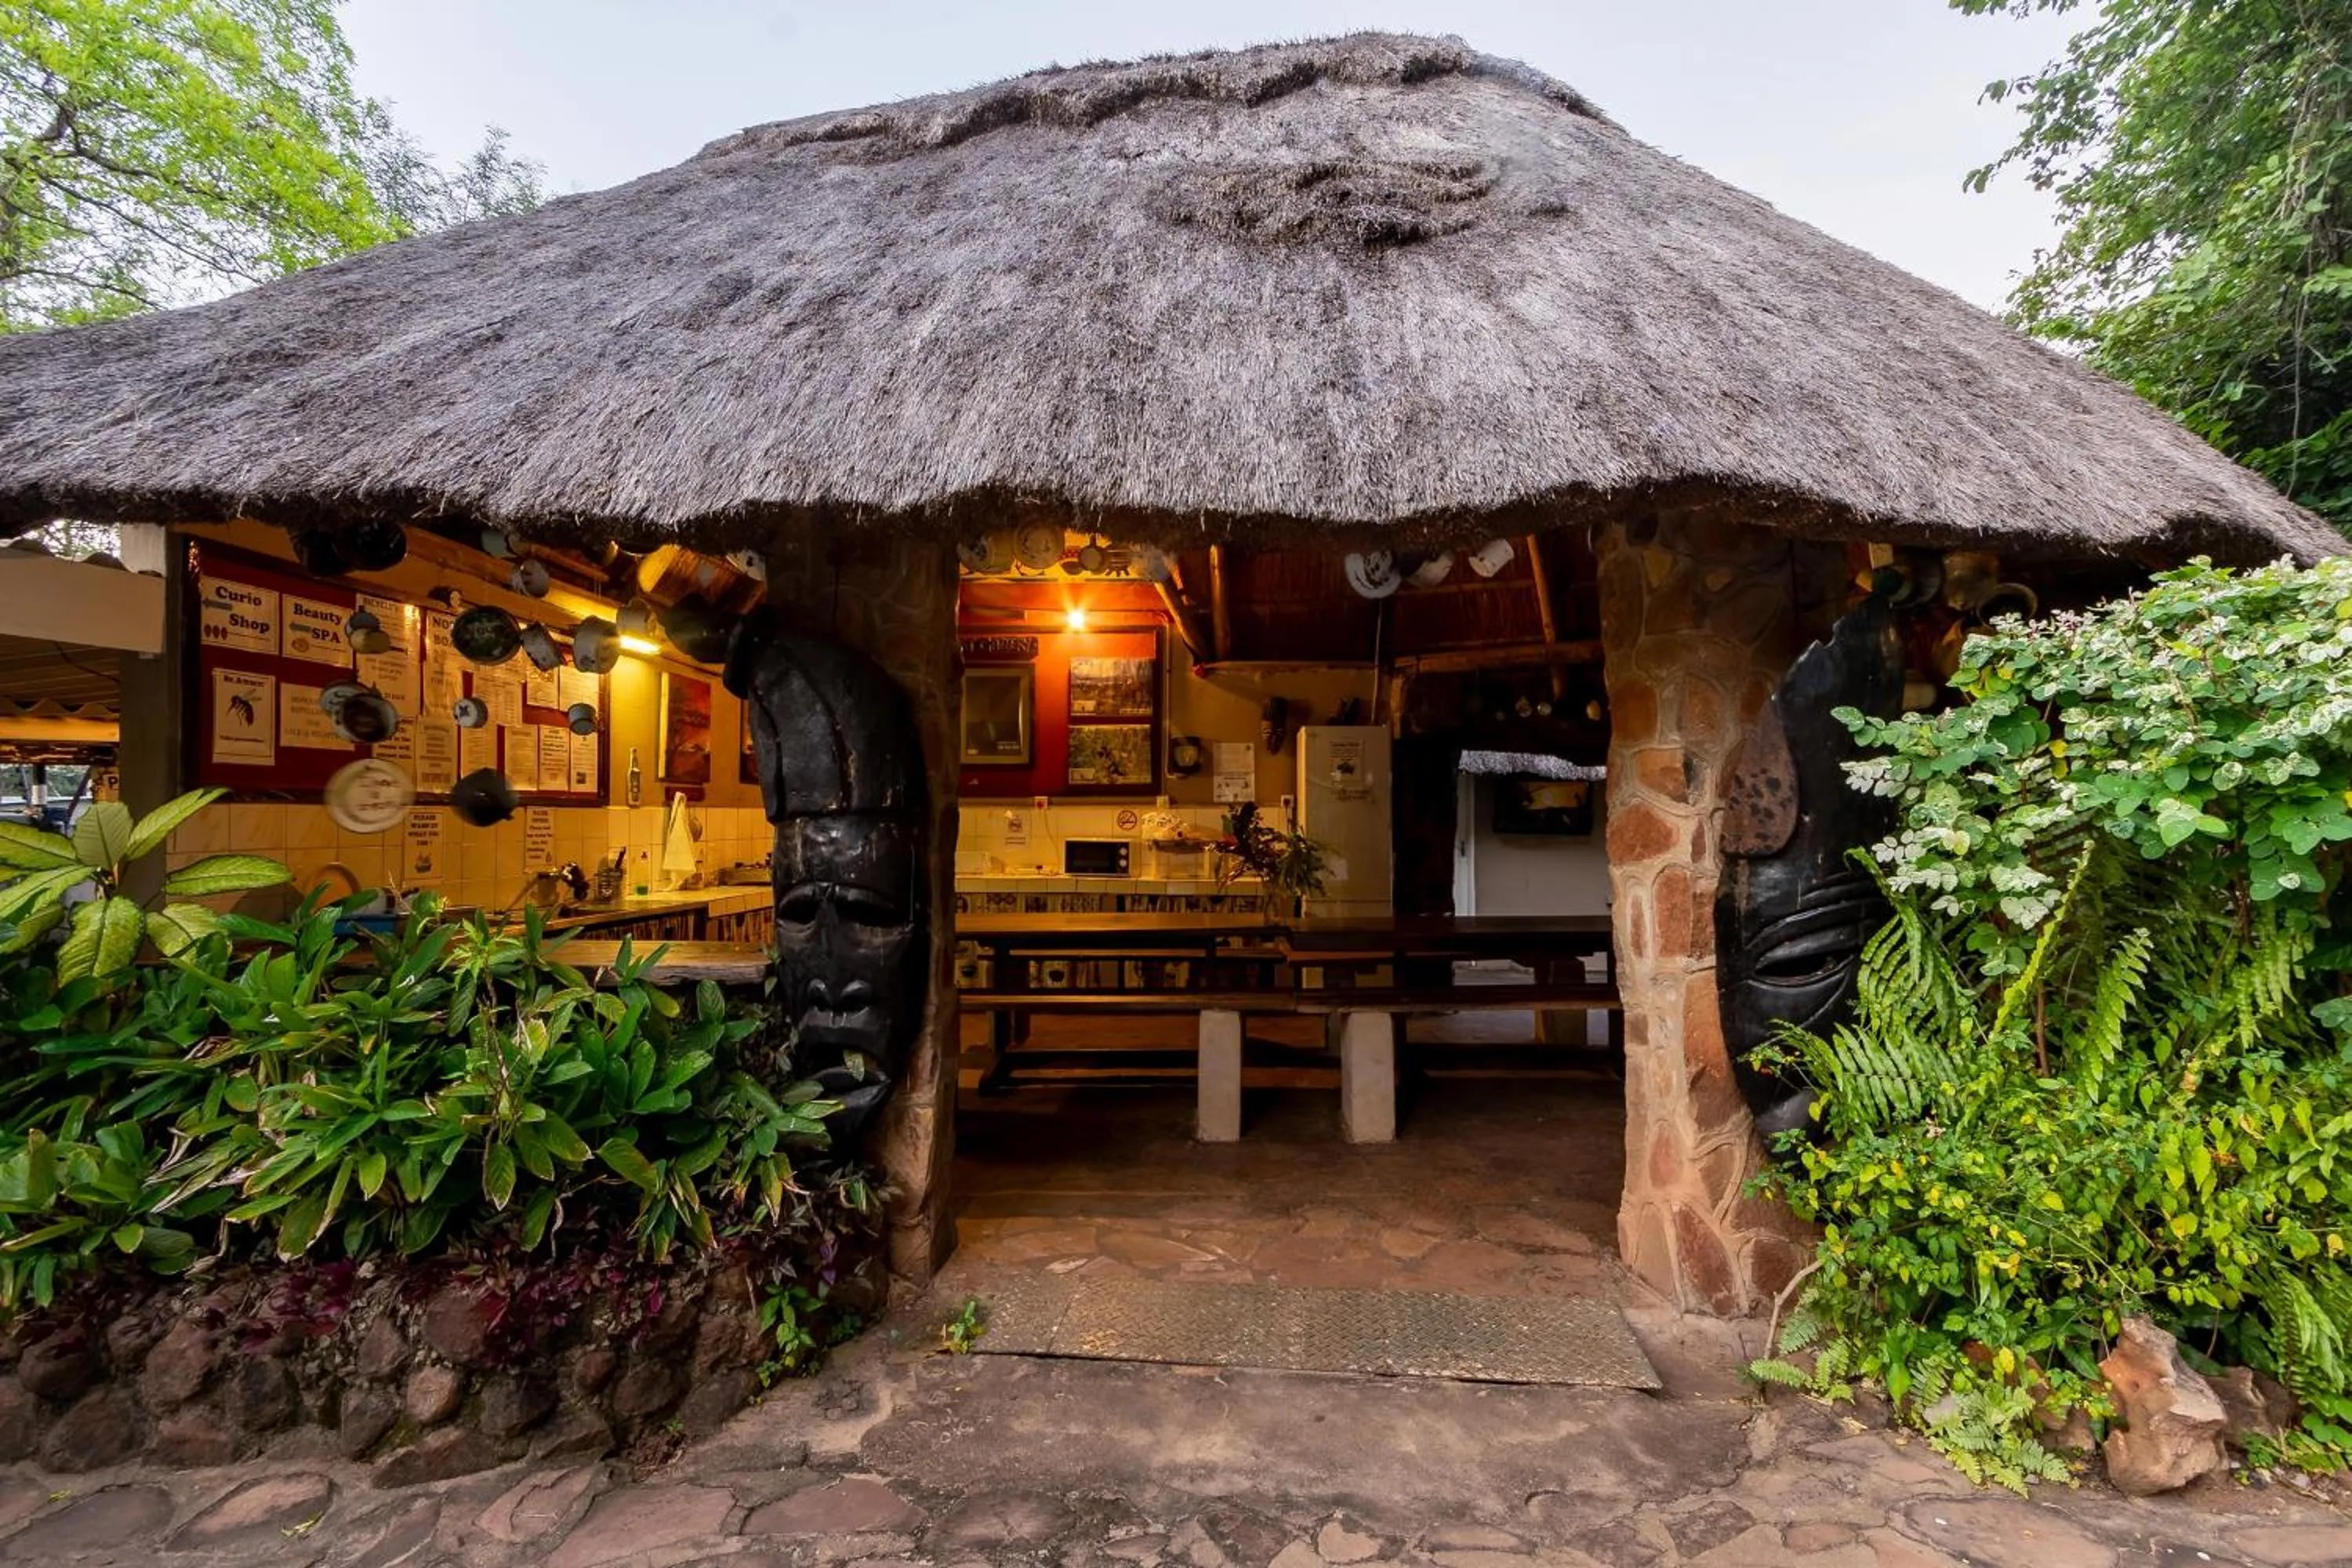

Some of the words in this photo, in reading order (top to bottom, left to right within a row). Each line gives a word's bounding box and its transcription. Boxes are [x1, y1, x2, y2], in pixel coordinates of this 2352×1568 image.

[216, 586, 262, 606] Curio
[229, 613, 270, 633] Shop
[293, 602, 342, 626] Beauty
[311, 628, 341, 644] SPA
